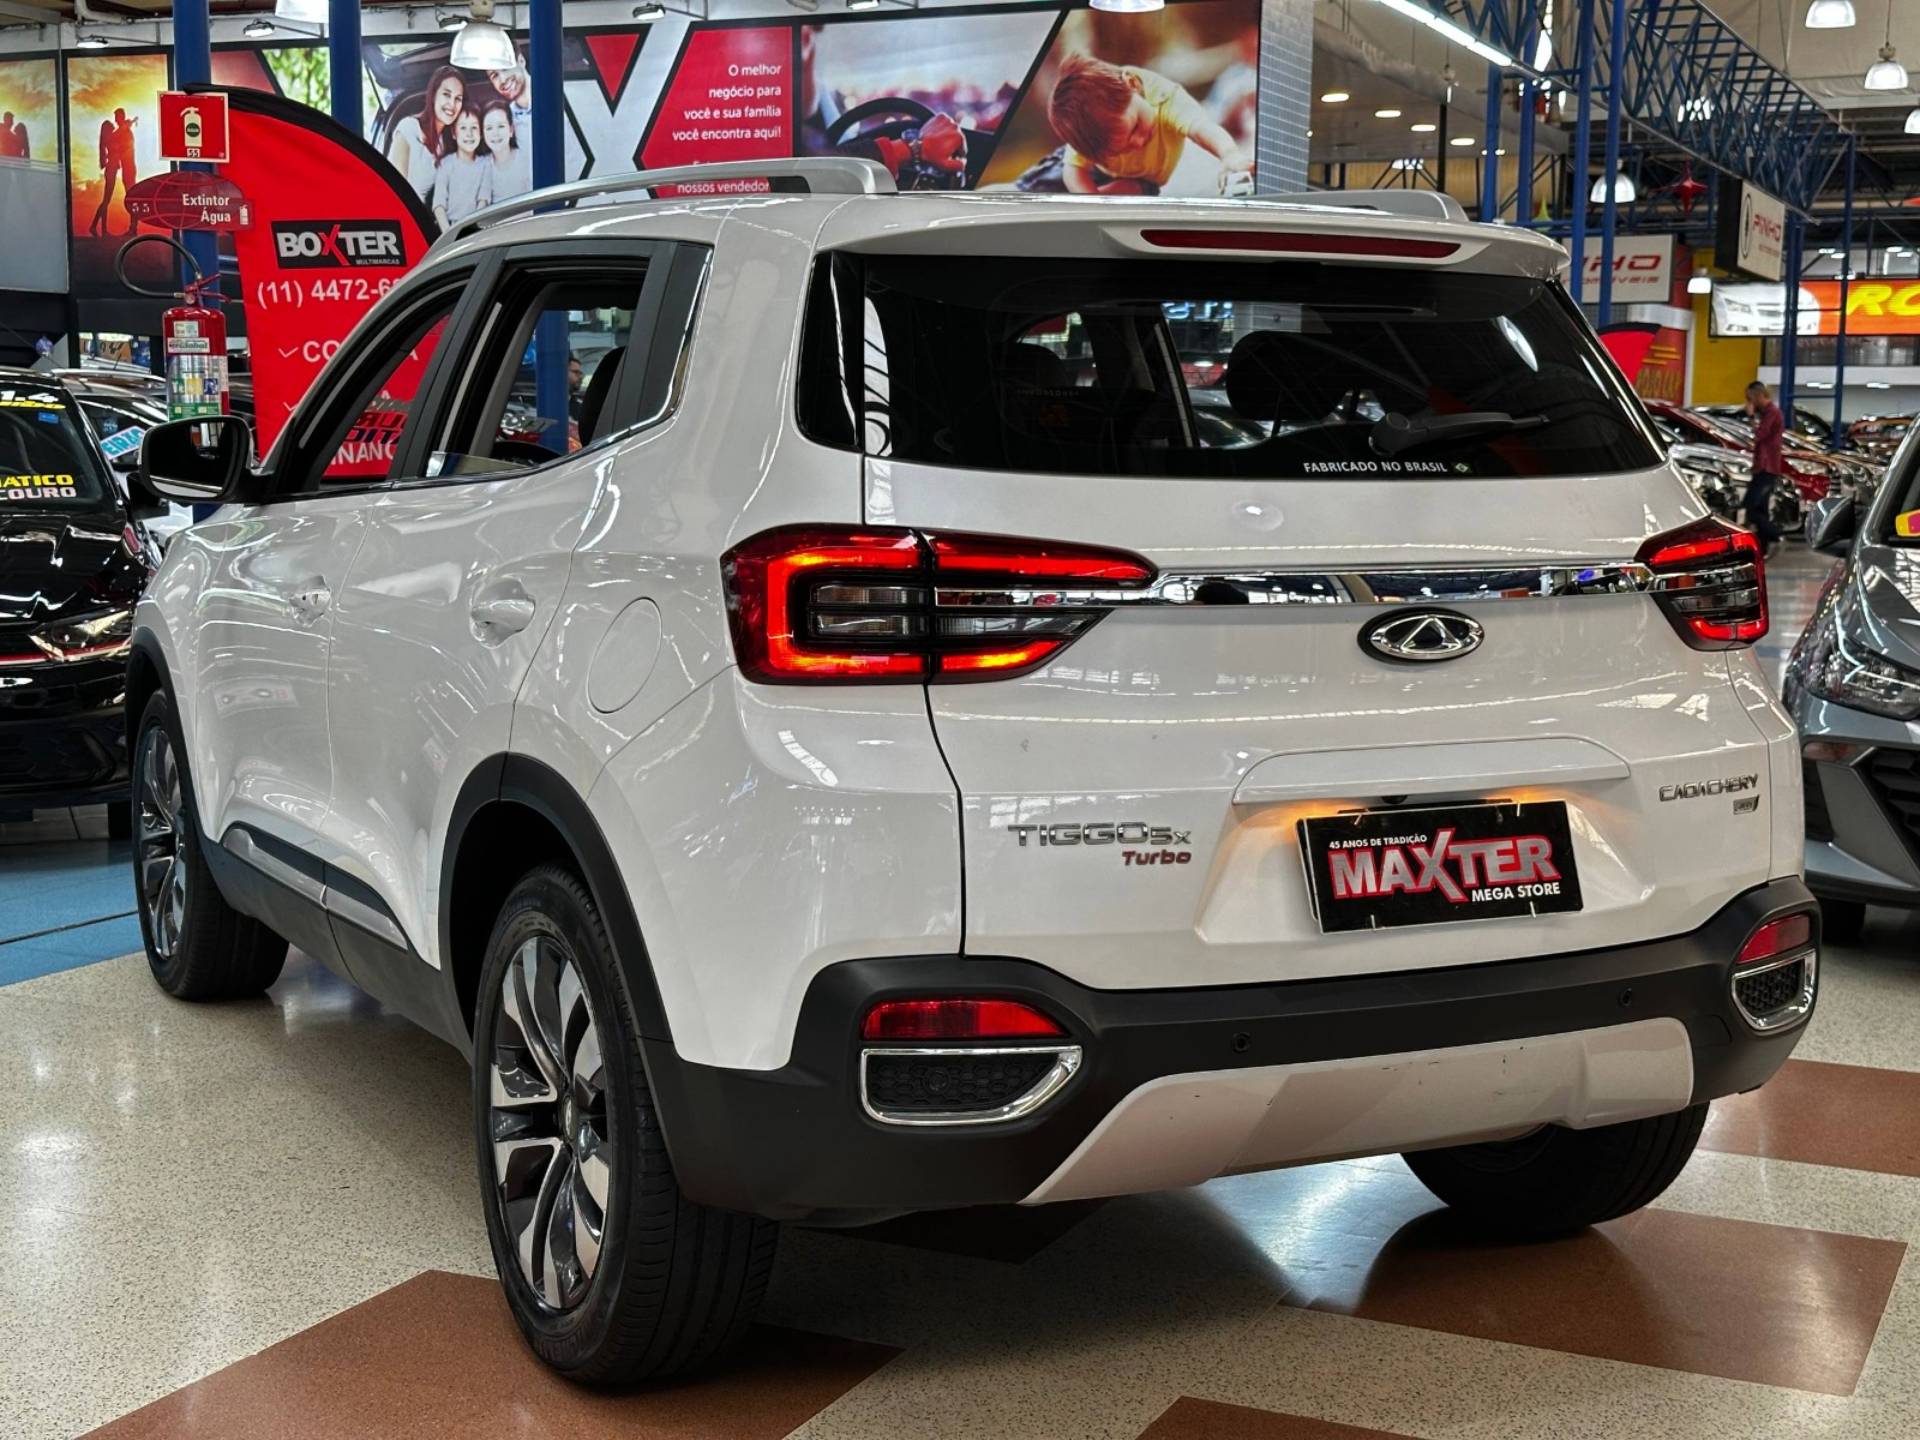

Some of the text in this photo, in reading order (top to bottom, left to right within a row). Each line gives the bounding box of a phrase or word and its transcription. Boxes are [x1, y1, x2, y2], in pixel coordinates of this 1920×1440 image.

[728, 64, 782, 76] O melhor
[708, 86, 782, 101] negócio para
[683, 104, 782, 120] você e sua família
[672, 127, 782, 141] você encontra aqui!
[677, 182, 715, 194] nossos
[181, 193, 230, 206] Extintor
[200, 207, 232, 224] Água
[276, 224, 400, 266] BOXTER
[257, 280, 304, 310] (11)
[1303, 461, 1448, 473] FABRICADO NO BRASIL
[0, 474, 74, 488] ATICO
[1328, 834, 1428, 849] 45 ANOS DE TRADIÇÃO
[1122, 849, 1192, 866] Turbo
[1327, 828, 1562, 903] MAXTER
[1471, 882, 1561, 902] MEGA STORE
